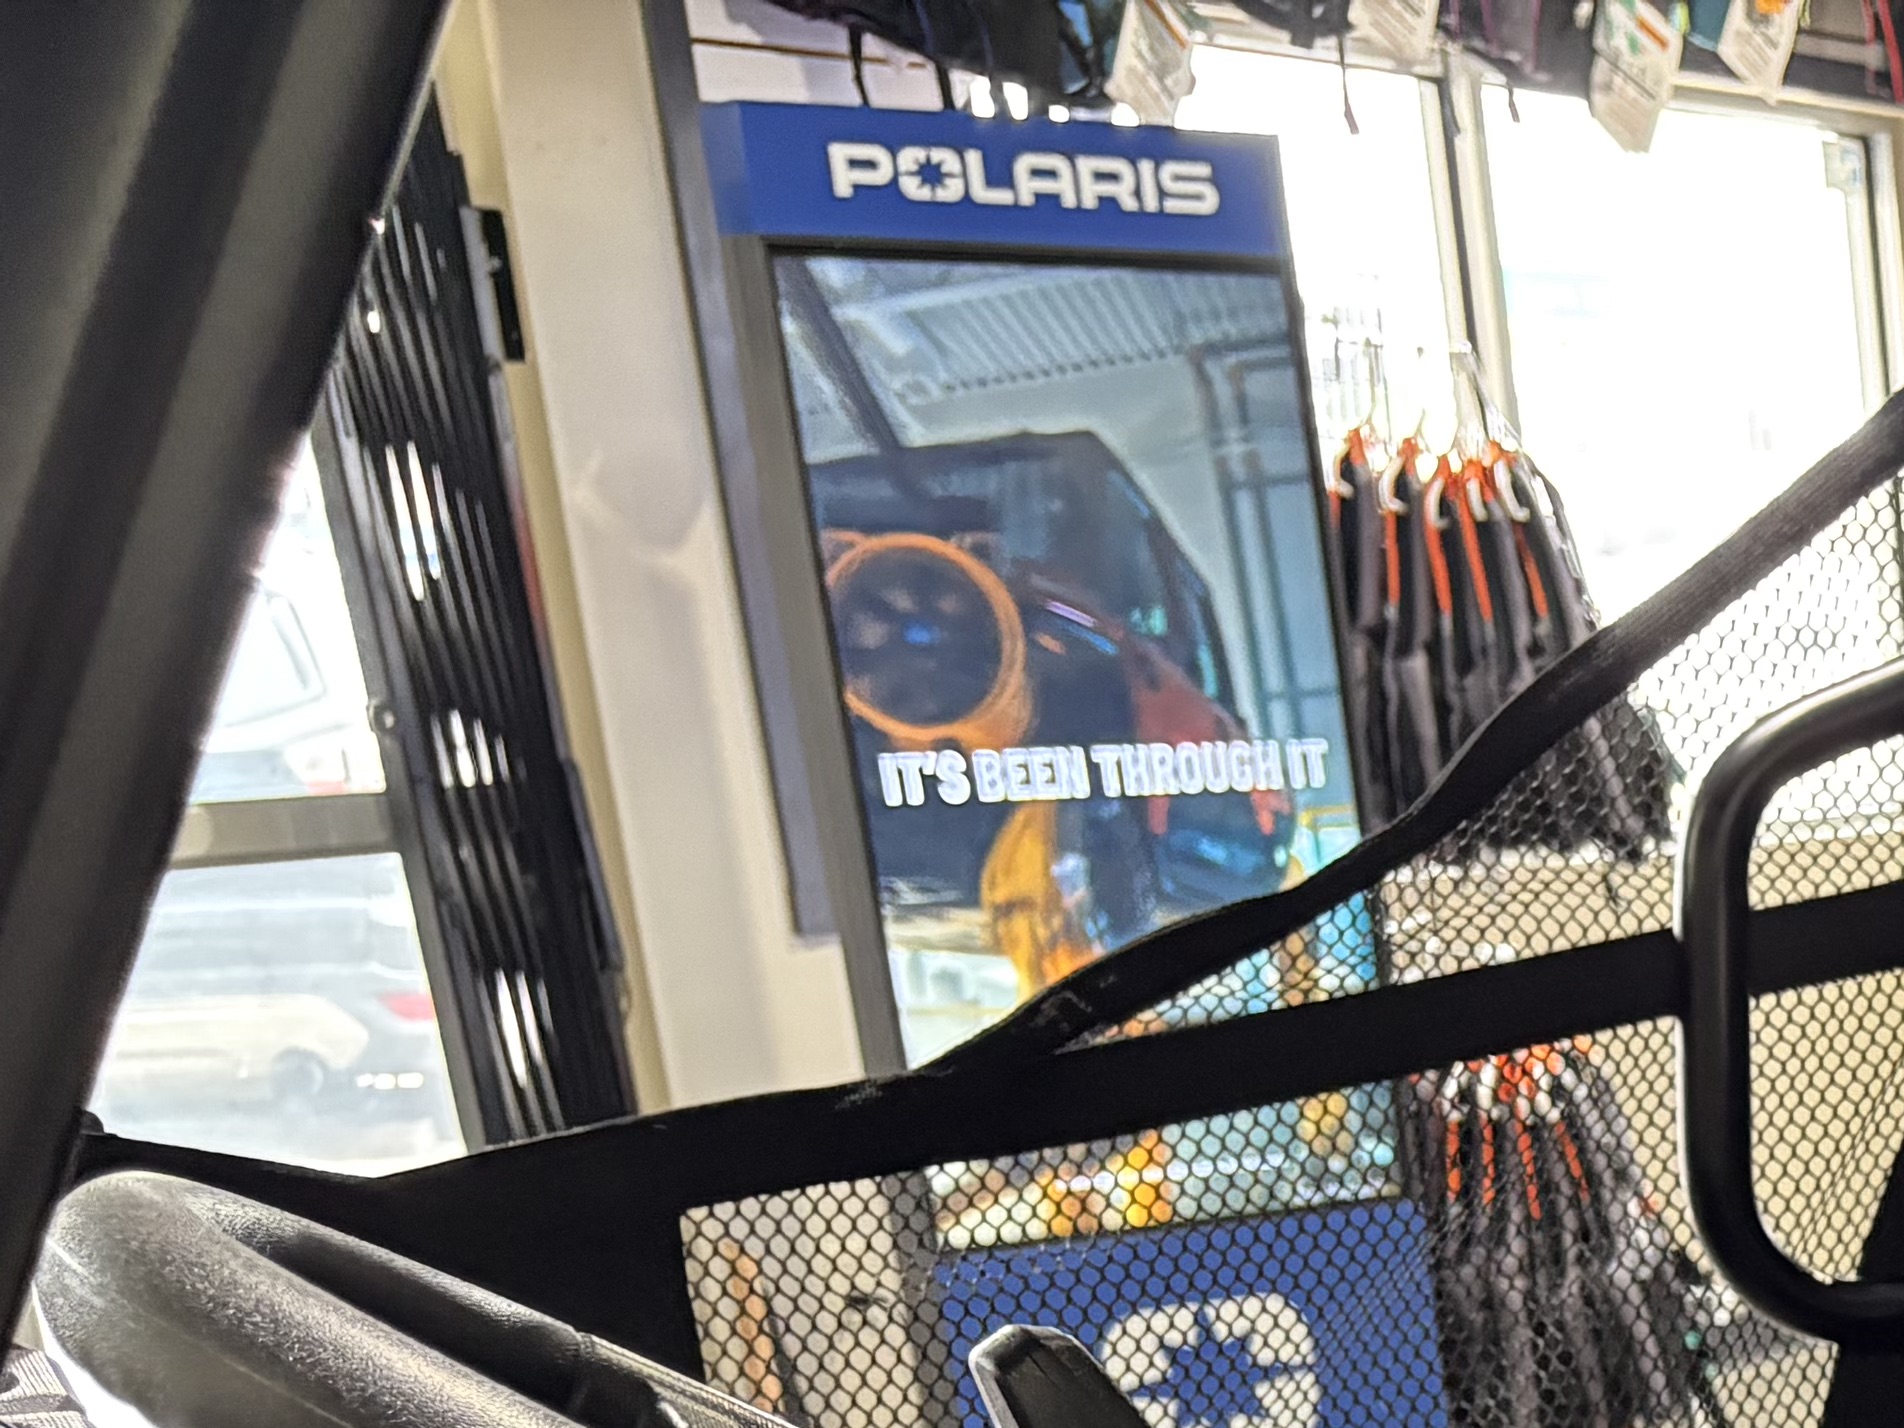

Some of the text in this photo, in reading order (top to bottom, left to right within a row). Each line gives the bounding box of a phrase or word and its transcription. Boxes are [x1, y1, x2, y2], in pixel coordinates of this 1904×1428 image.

[827, 141, 1221, 216] POLARIS
[878, 738, 1329, 806] IT'S BEEN THROUGH IT
